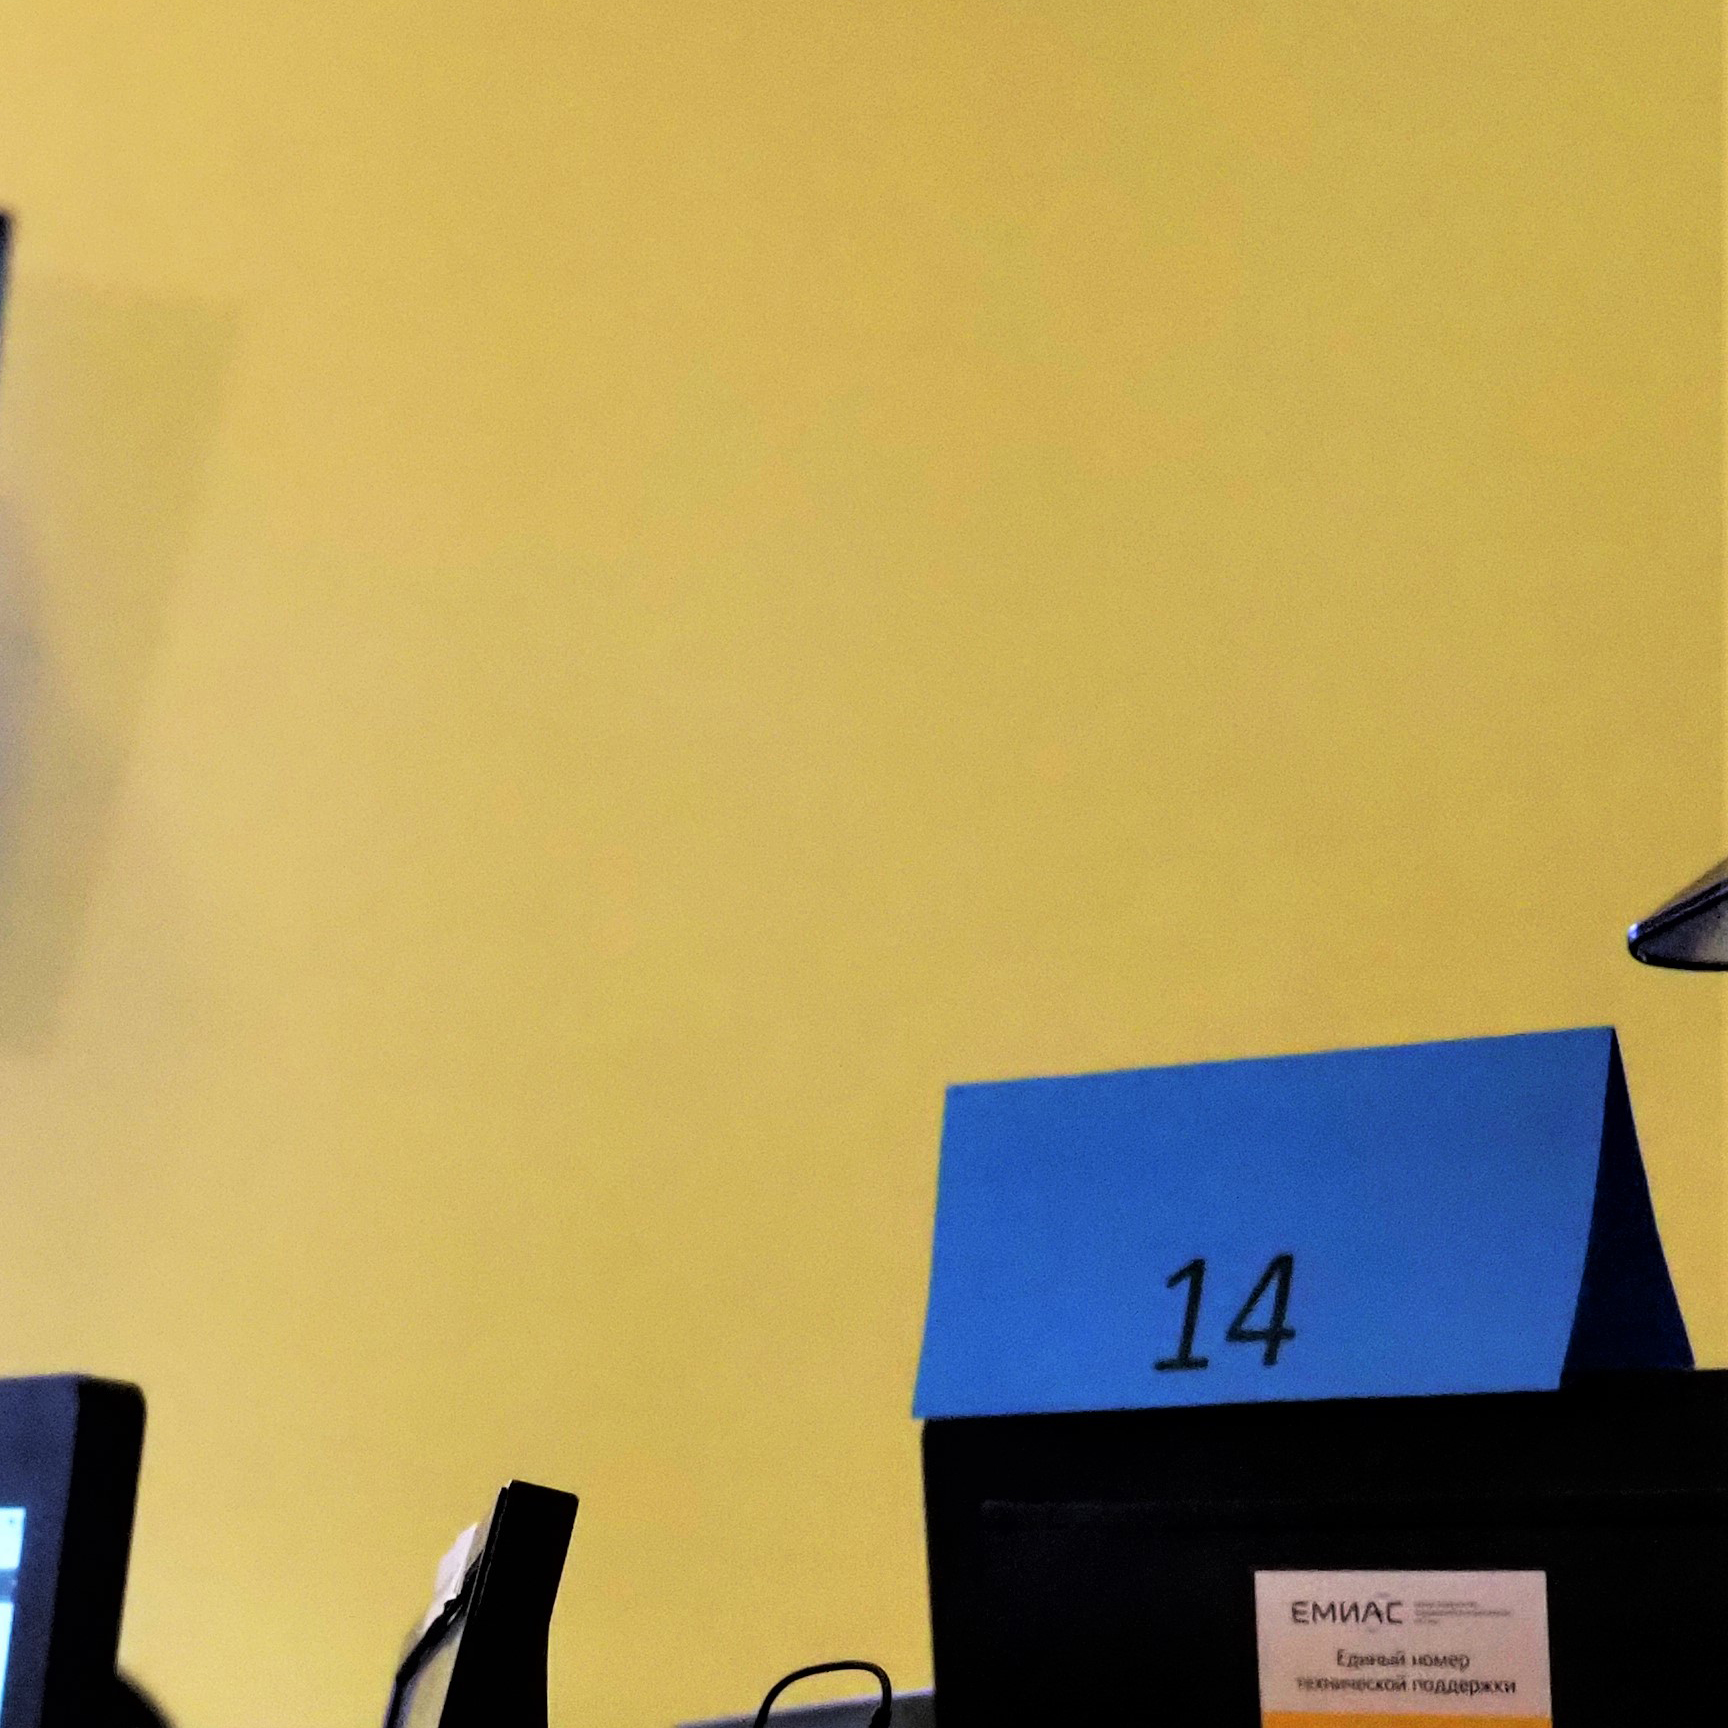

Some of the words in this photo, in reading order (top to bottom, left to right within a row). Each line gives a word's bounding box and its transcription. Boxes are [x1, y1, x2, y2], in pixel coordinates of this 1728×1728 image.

[1154, 1254, 1296, 1371] 14
[1290, 1599, 1404, 1625] ЕМИАС
[1336, 1648, 1406, 1669] Единый
[1411, 1652, 1471, 1672] номер
[1296, 1675, 1407, 1693] технической
[1411, 1678, 1517, 1697] поддержки
